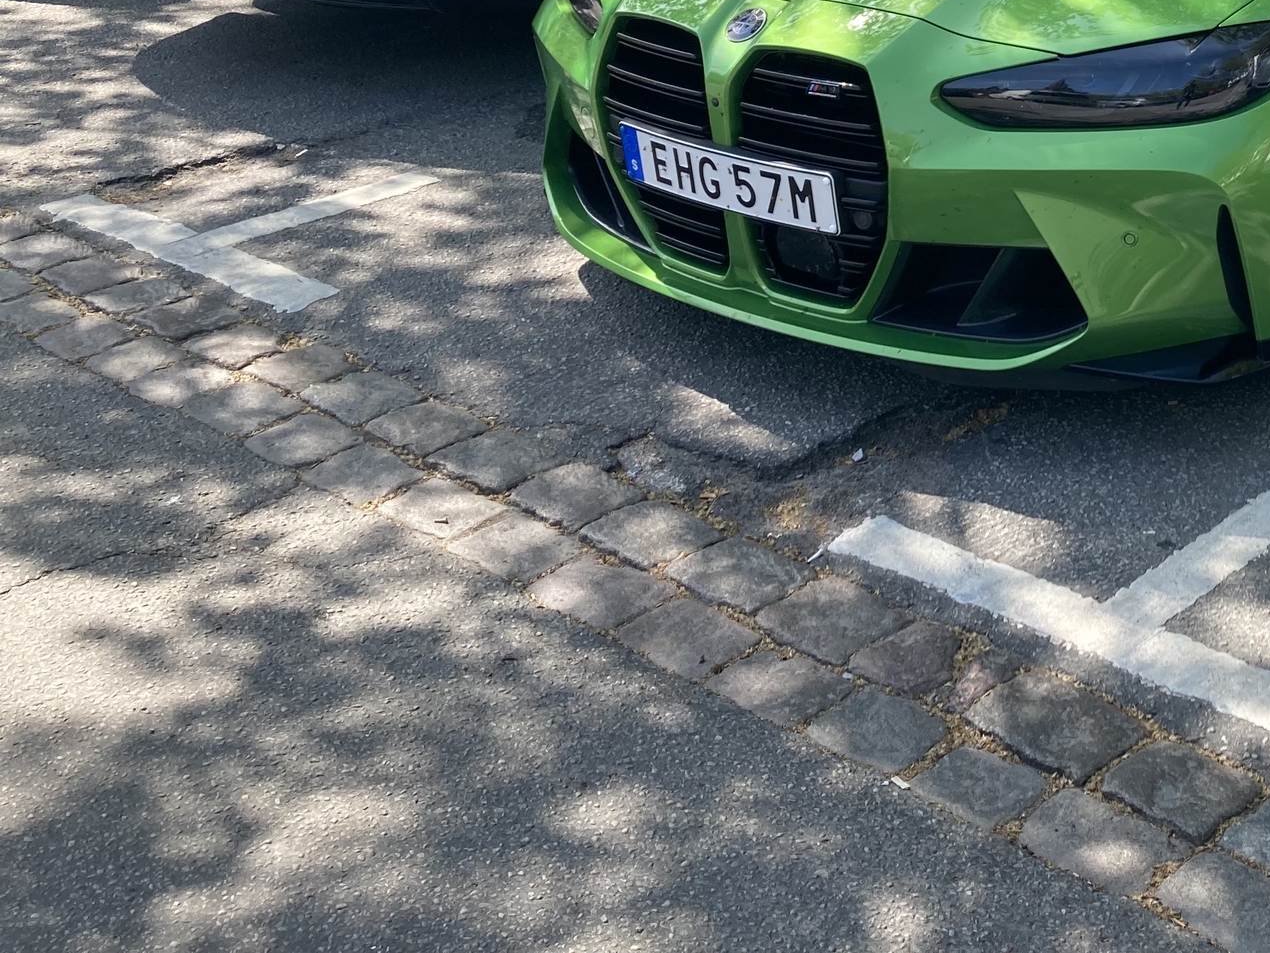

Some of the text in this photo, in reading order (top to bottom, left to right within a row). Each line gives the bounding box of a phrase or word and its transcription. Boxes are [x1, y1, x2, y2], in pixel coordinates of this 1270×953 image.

[631, 140, 817, 223] S EHG 57M
